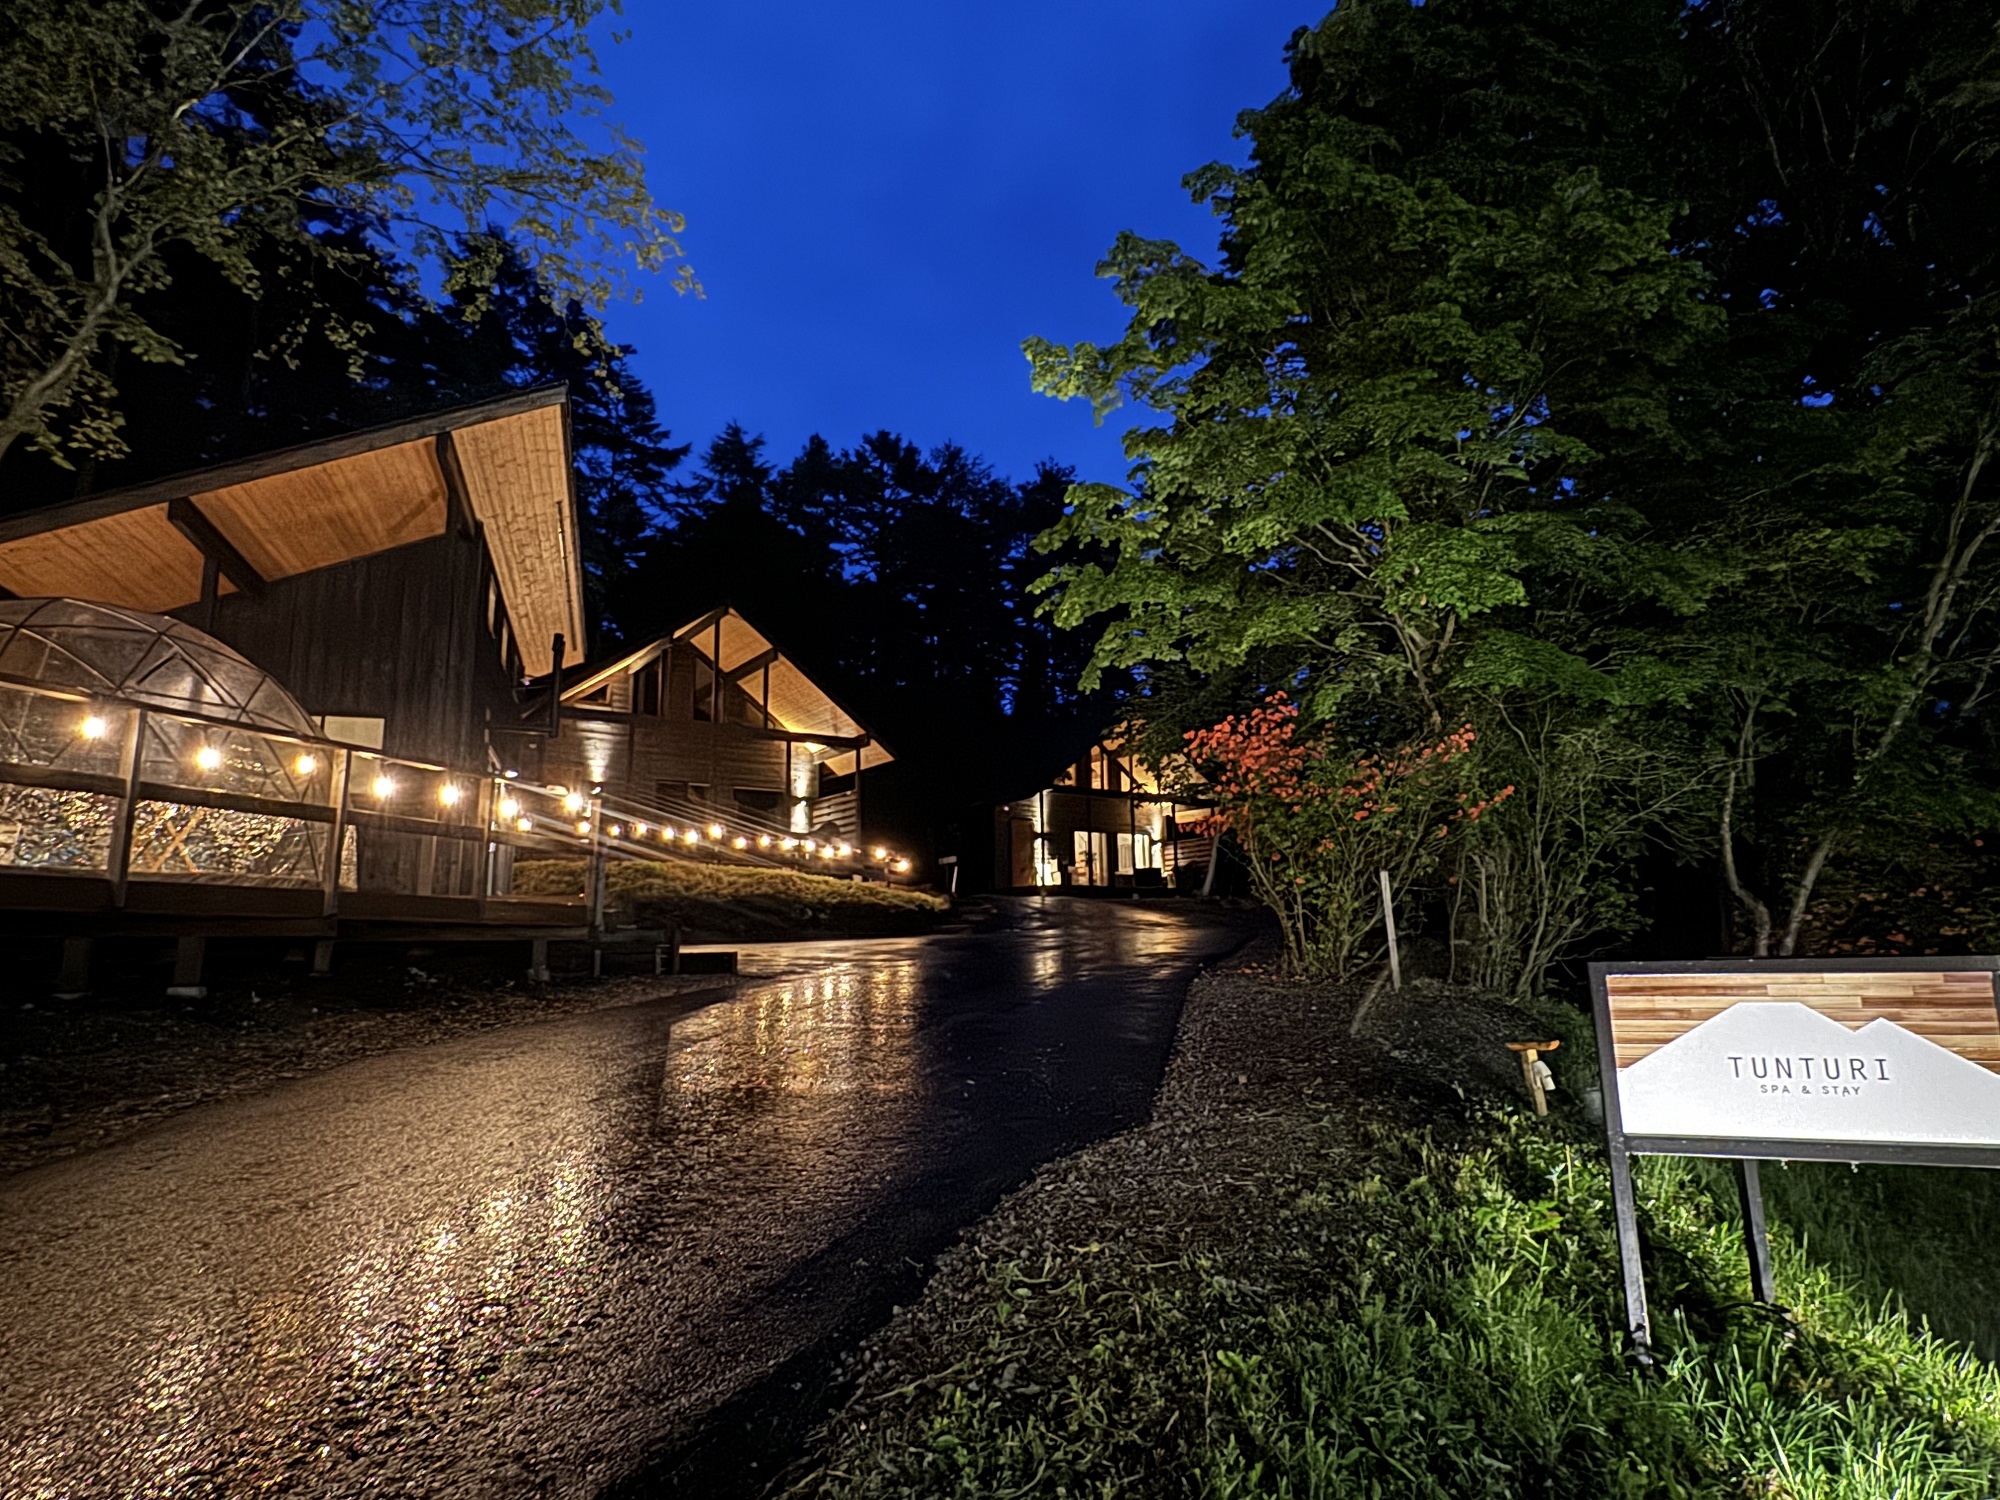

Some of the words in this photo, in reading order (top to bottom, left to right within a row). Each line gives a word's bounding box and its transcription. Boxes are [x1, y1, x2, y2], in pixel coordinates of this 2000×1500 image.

[1727, 1056, 1890, 1081] TUNTURI
[1760, 1084, 1790, 1094] SPA
[1801, 1085, 1812, 1095] &
[1821, 1085, 1861, 1096] STAY
